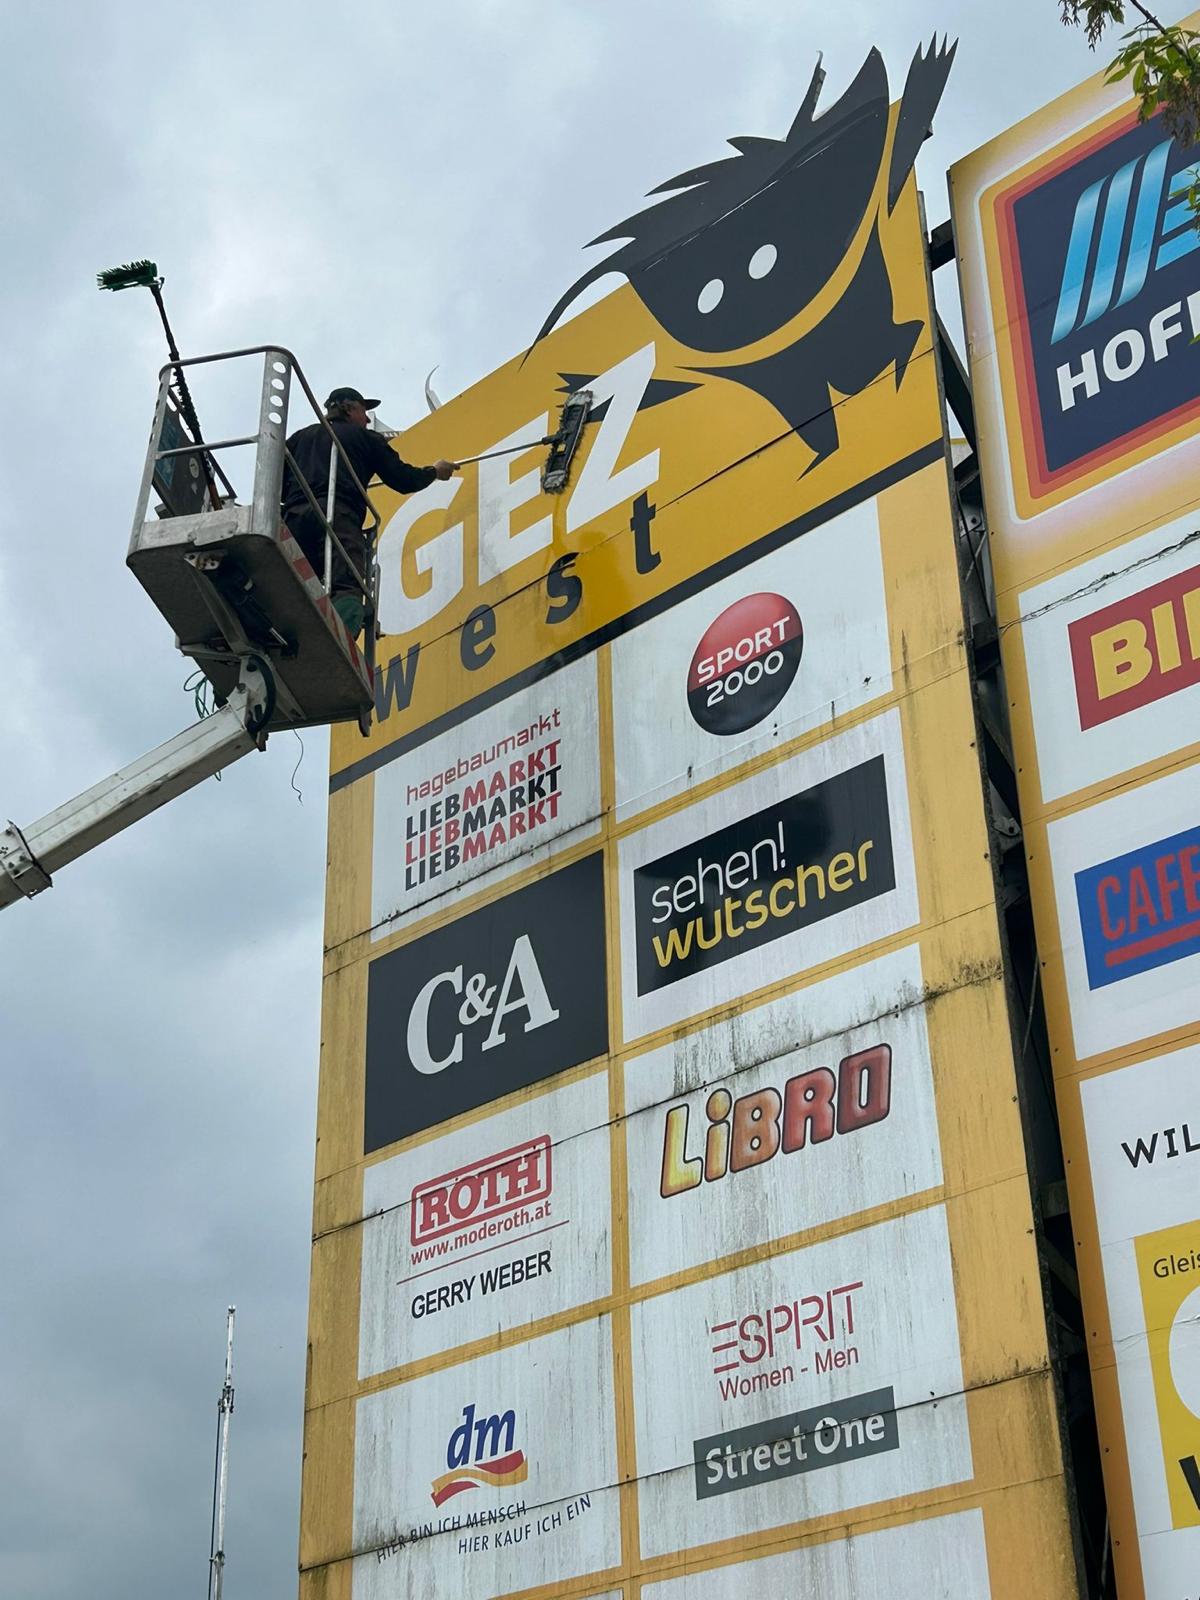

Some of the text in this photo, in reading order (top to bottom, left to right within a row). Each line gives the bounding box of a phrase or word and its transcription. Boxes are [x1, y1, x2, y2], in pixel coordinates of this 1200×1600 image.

[377, 341, 660, 635] GEZ
[374, 490, 661, 723] west
[697, 616, 790, 684] SPORT
[706, 651, 784, 707] 2000
[406, 738, 561, 840] LIEBMARKT
[407, 707, 560, 805] hagebaumarkt
[405, 765, 562, 866] LIEBMARKT
[405, 791, 562, 891] LIEBMARKT
[652, 821, 786, 924] sehen!
[652, 840, 873, 968] wutscher
[406, 934, 559, 1075] C&A
[411, 1200, 551, 1265] www.moderoth.at
[420, 1149, 541, 1233] ROTH
[411, 1250, 552, 1319] GERRY WEBER
[711, 1281, 863, 1374] ESPRIT
[719, 1366, 793, 1401] Women
[815, 1347, 859, 1375] Men
[447, 1403, 515, 1469] dm
[706, 1413, 885, 1485] Street One
[376, 1500, 527, 1564] HIER BIN ICH MENSCH
[458, 1494, 592, 1555] HIER KAUF ICH EIN
